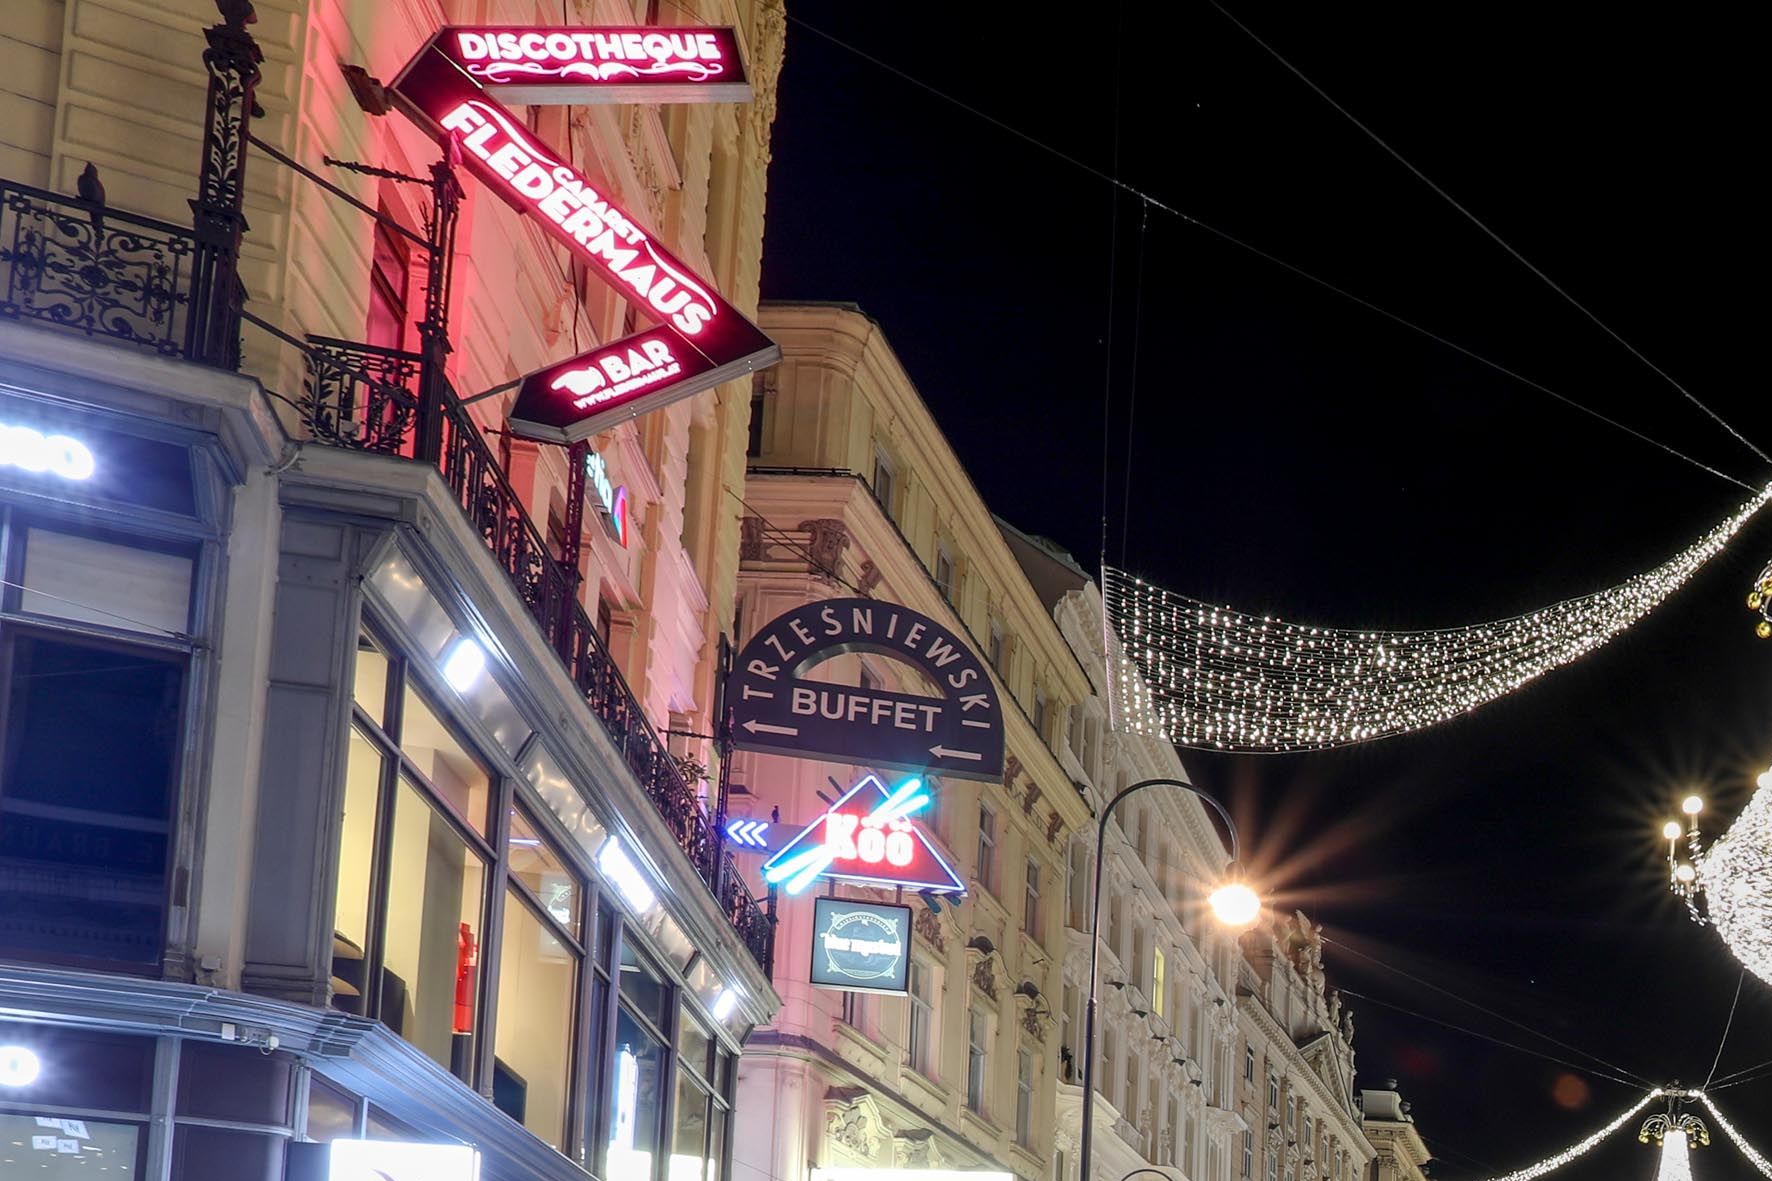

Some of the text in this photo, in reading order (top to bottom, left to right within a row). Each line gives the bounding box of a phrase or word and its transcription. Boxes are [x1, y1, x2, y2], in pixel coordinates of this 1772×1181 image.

[458, 32, 721, 65] DISCOTHEQUE
[440, 102, 712, 336] FLEDERMAUS
[552, 166, 647, 246] CABARET
[599, 339, 676, 384] BAR
[791, 687, 943, 733] BUFFET
